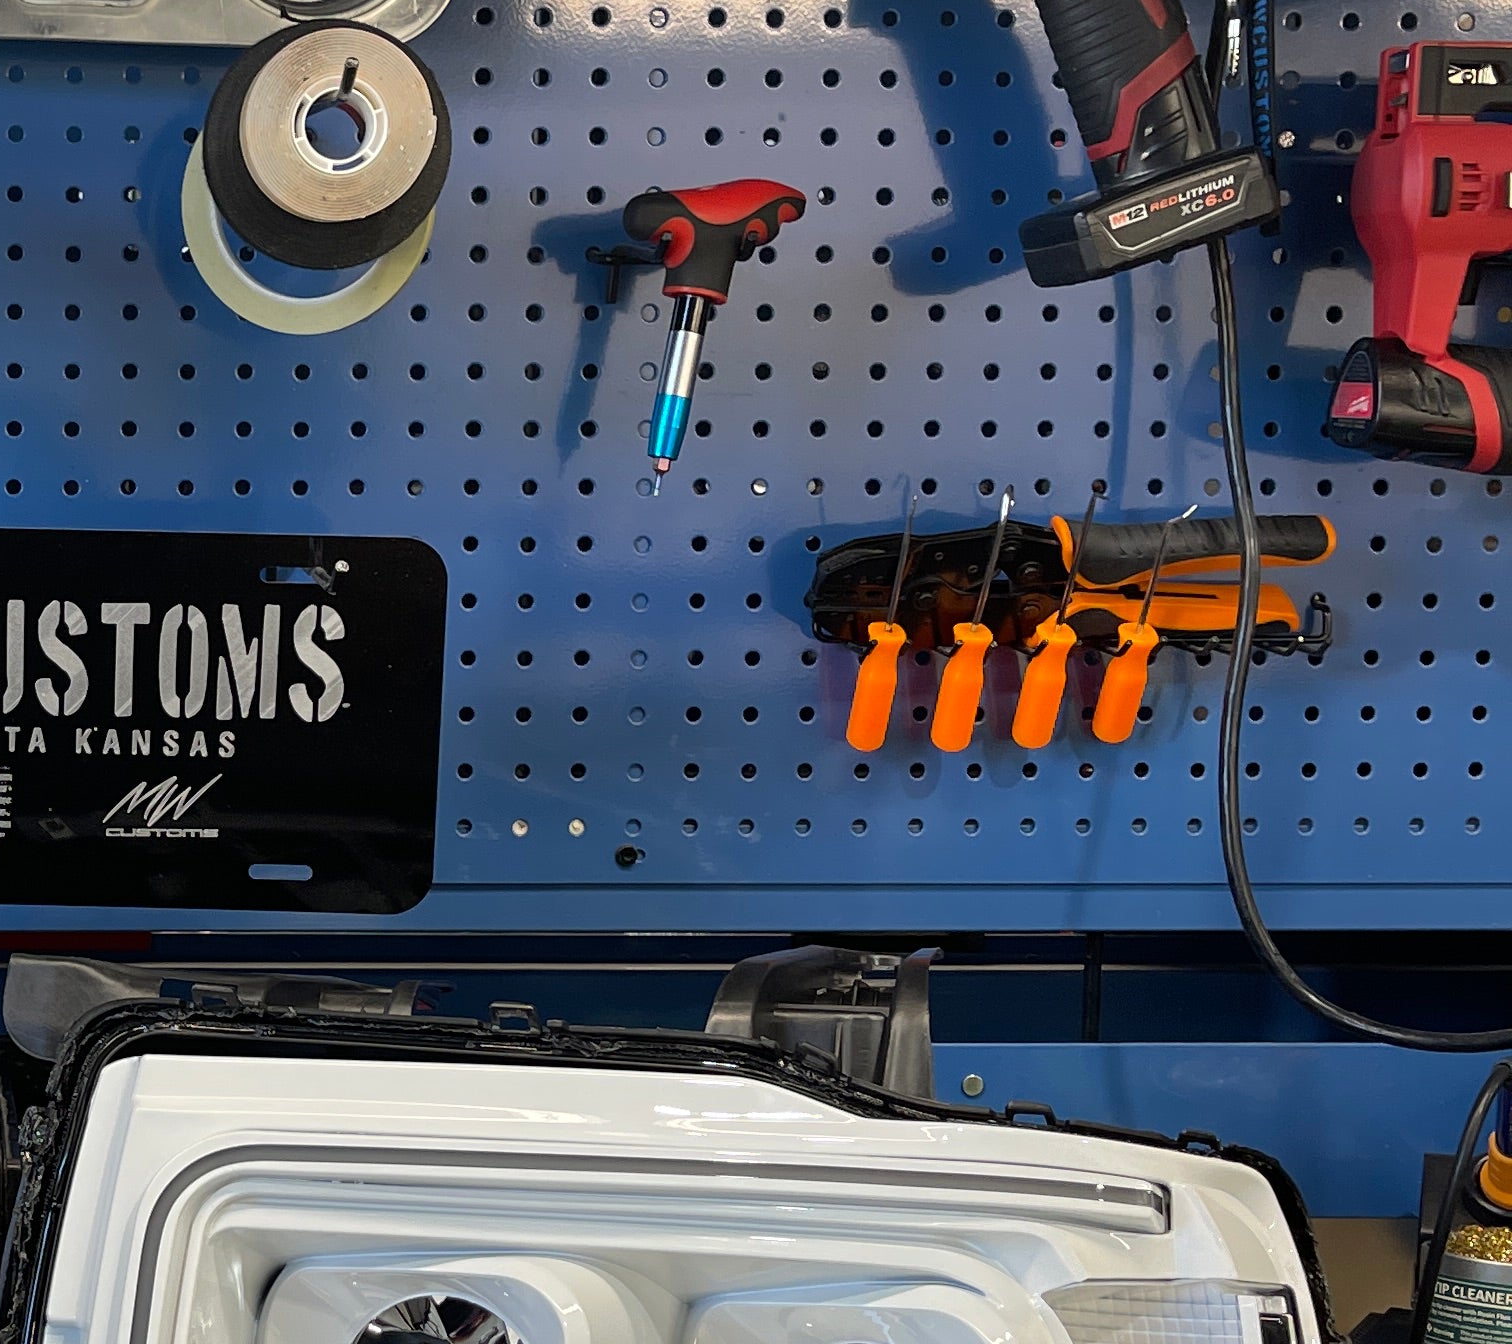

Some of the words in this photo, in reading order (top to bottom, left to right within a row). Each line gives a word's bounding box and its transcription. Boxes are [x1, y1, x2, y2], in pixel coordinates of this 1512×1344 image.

[1111, 207, 1145, 226] M12
[1150, 175, 1235, 213] REDLITHIUM
[75, 726, 237, 759] KANSAS
[105, 828, 220, 838] CUSTOMS
[1451, 1285, 1512, 1306] CLEANER
